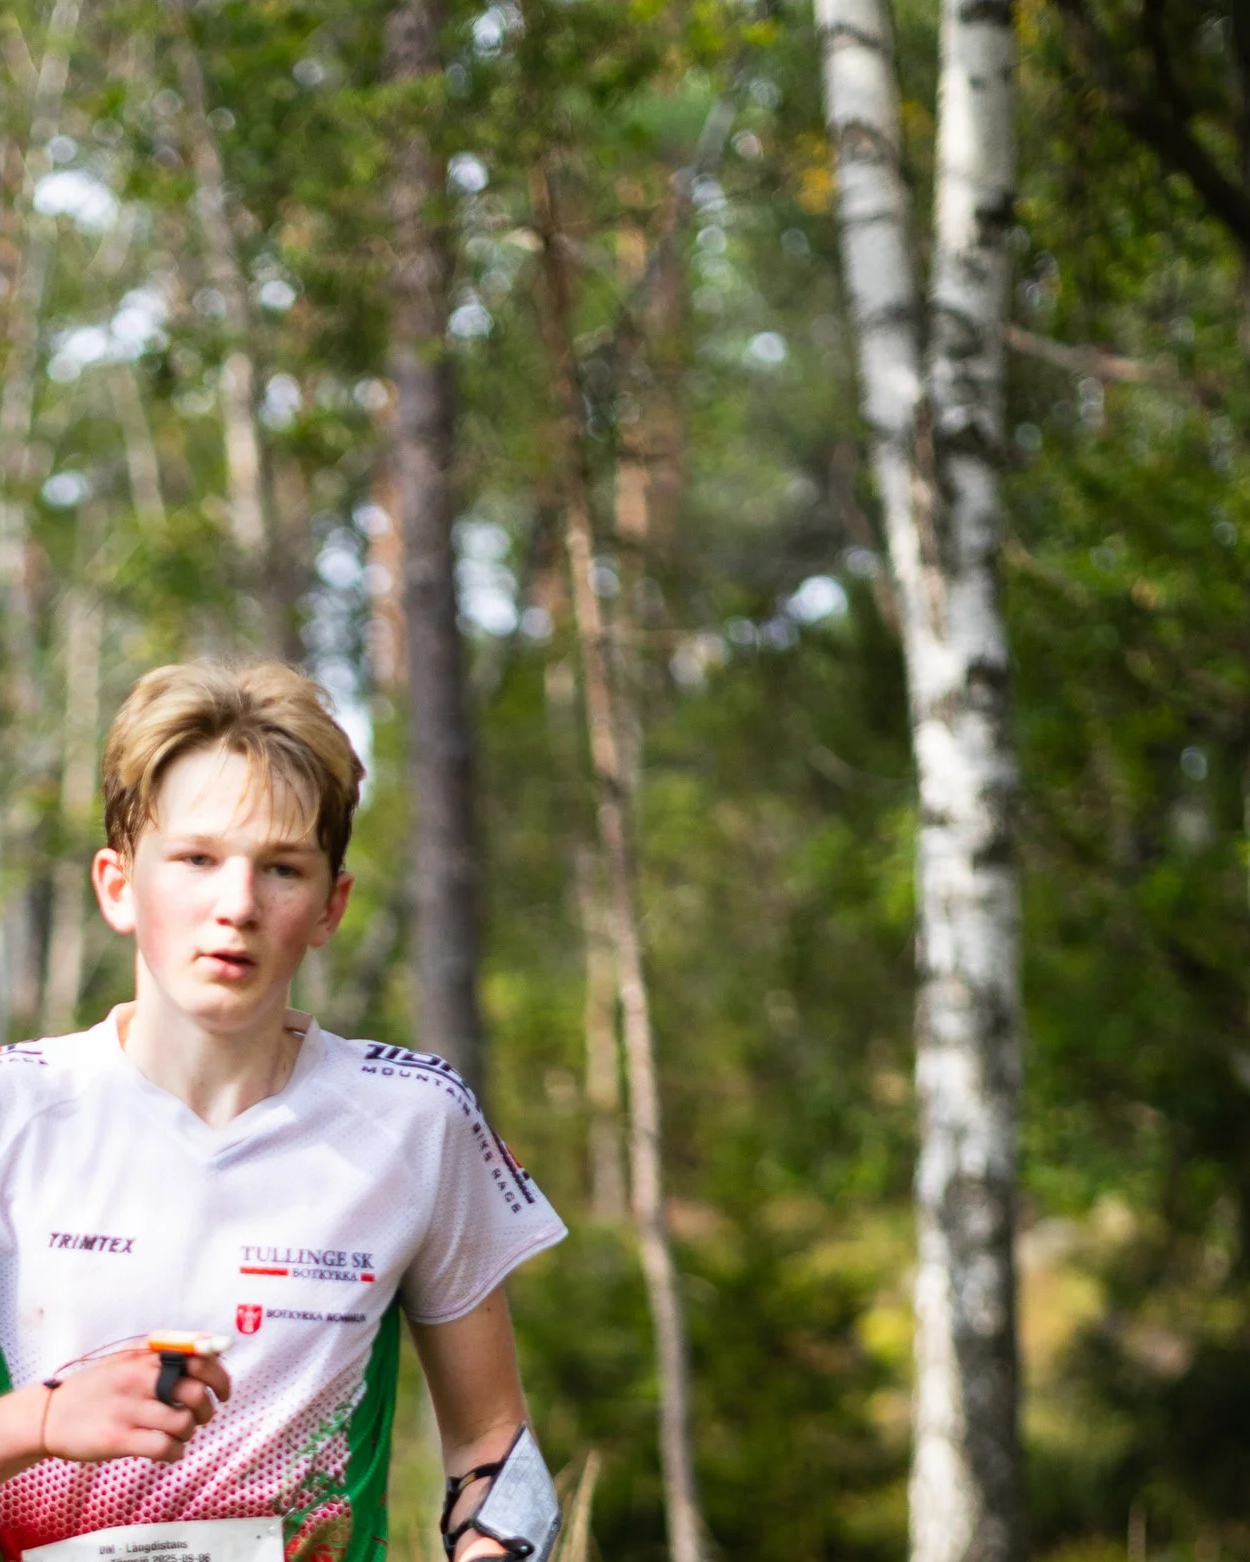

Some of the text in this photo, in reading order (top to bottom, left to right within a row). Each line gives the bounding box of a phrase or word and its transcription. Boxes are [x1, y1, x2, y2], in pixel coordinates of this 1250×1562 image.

[361, 1065, 471, 1116] MOUNTAIN
[472, 1121, 494, 1162] BIKE
[491, 1167, 522, 1214] RACE
[48, 1231, 136, 1254] TRIMTEX
[240, 1246, 374, 1269] TULLINGE SK
[292, 1268, 358, 1281] BOTKYRKA
[266, 1308, 323, 1321] BOTKYRKA
[126, 1540, 188, 1554] Långdistans
